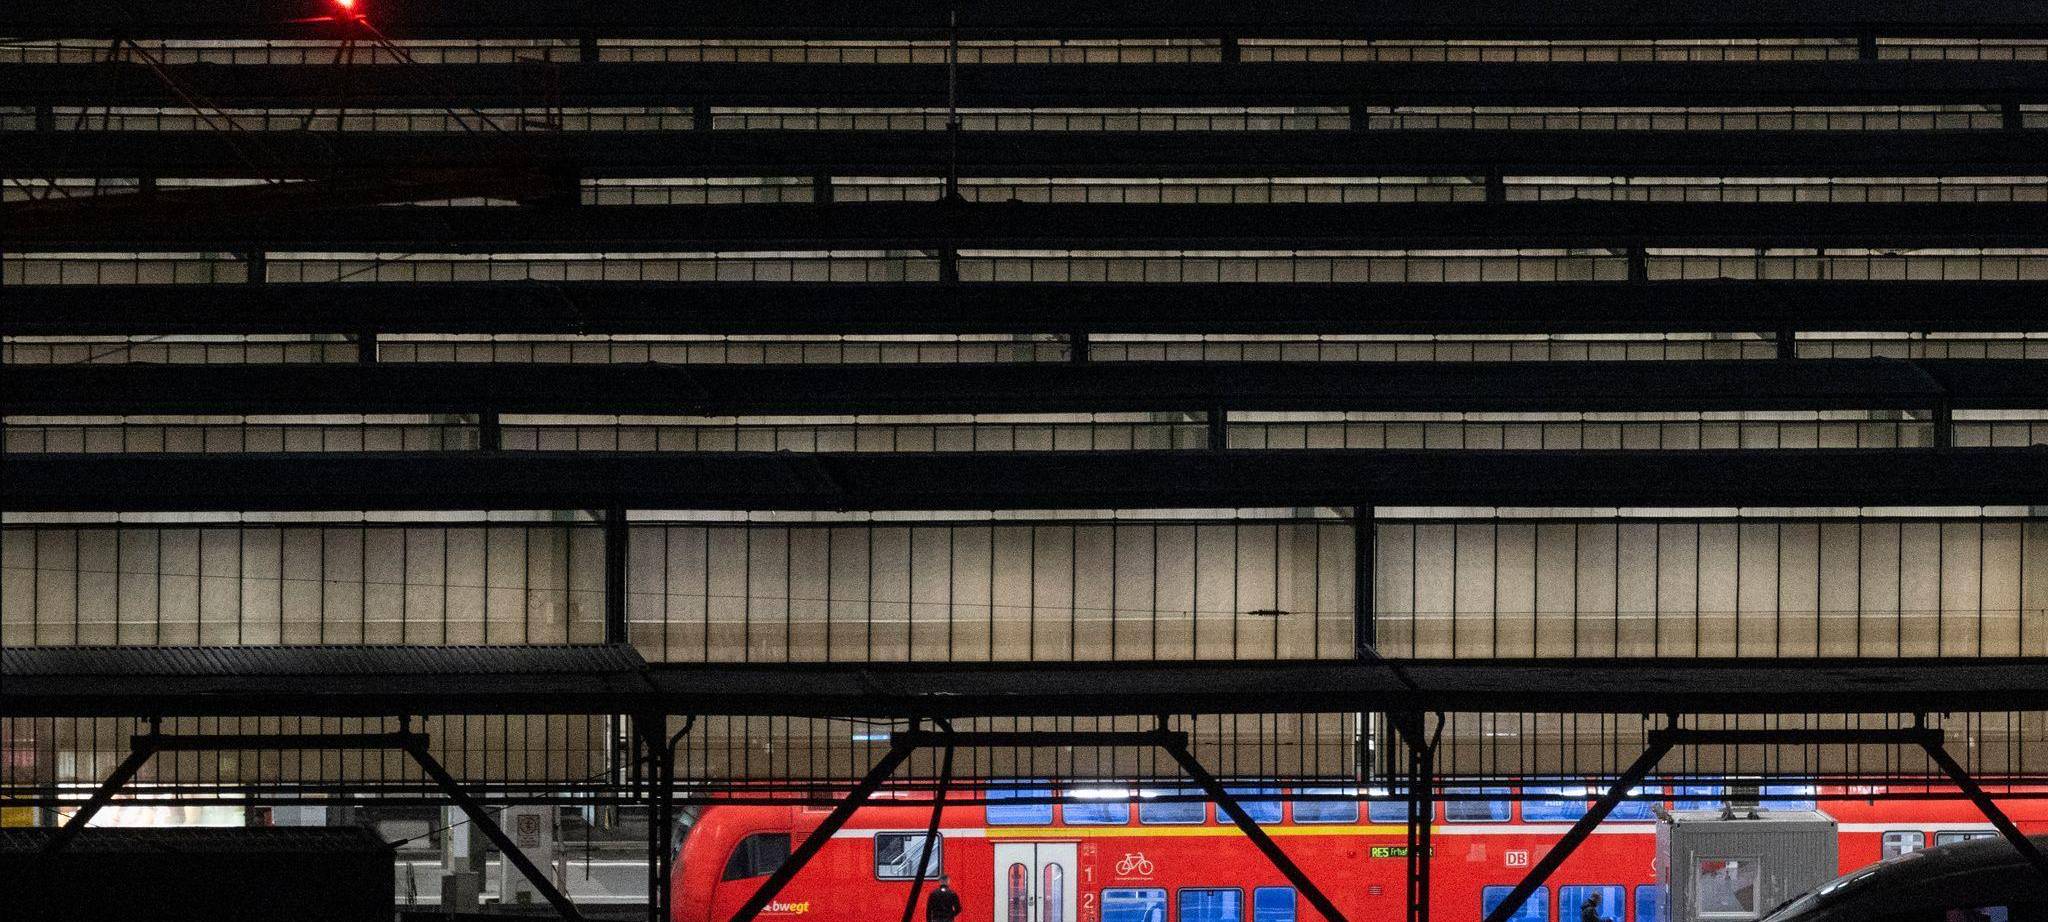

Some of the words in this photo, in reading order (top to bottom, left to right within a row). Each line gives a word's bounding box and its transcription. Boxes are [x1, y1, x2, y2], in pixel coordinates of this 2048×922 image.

[1507, 852, 1527, 865] DB
[1085, 867, 1092, 882] 1
[772, 900, 810, 915] bwegt
[1083, 893, 1095, 909] 2
